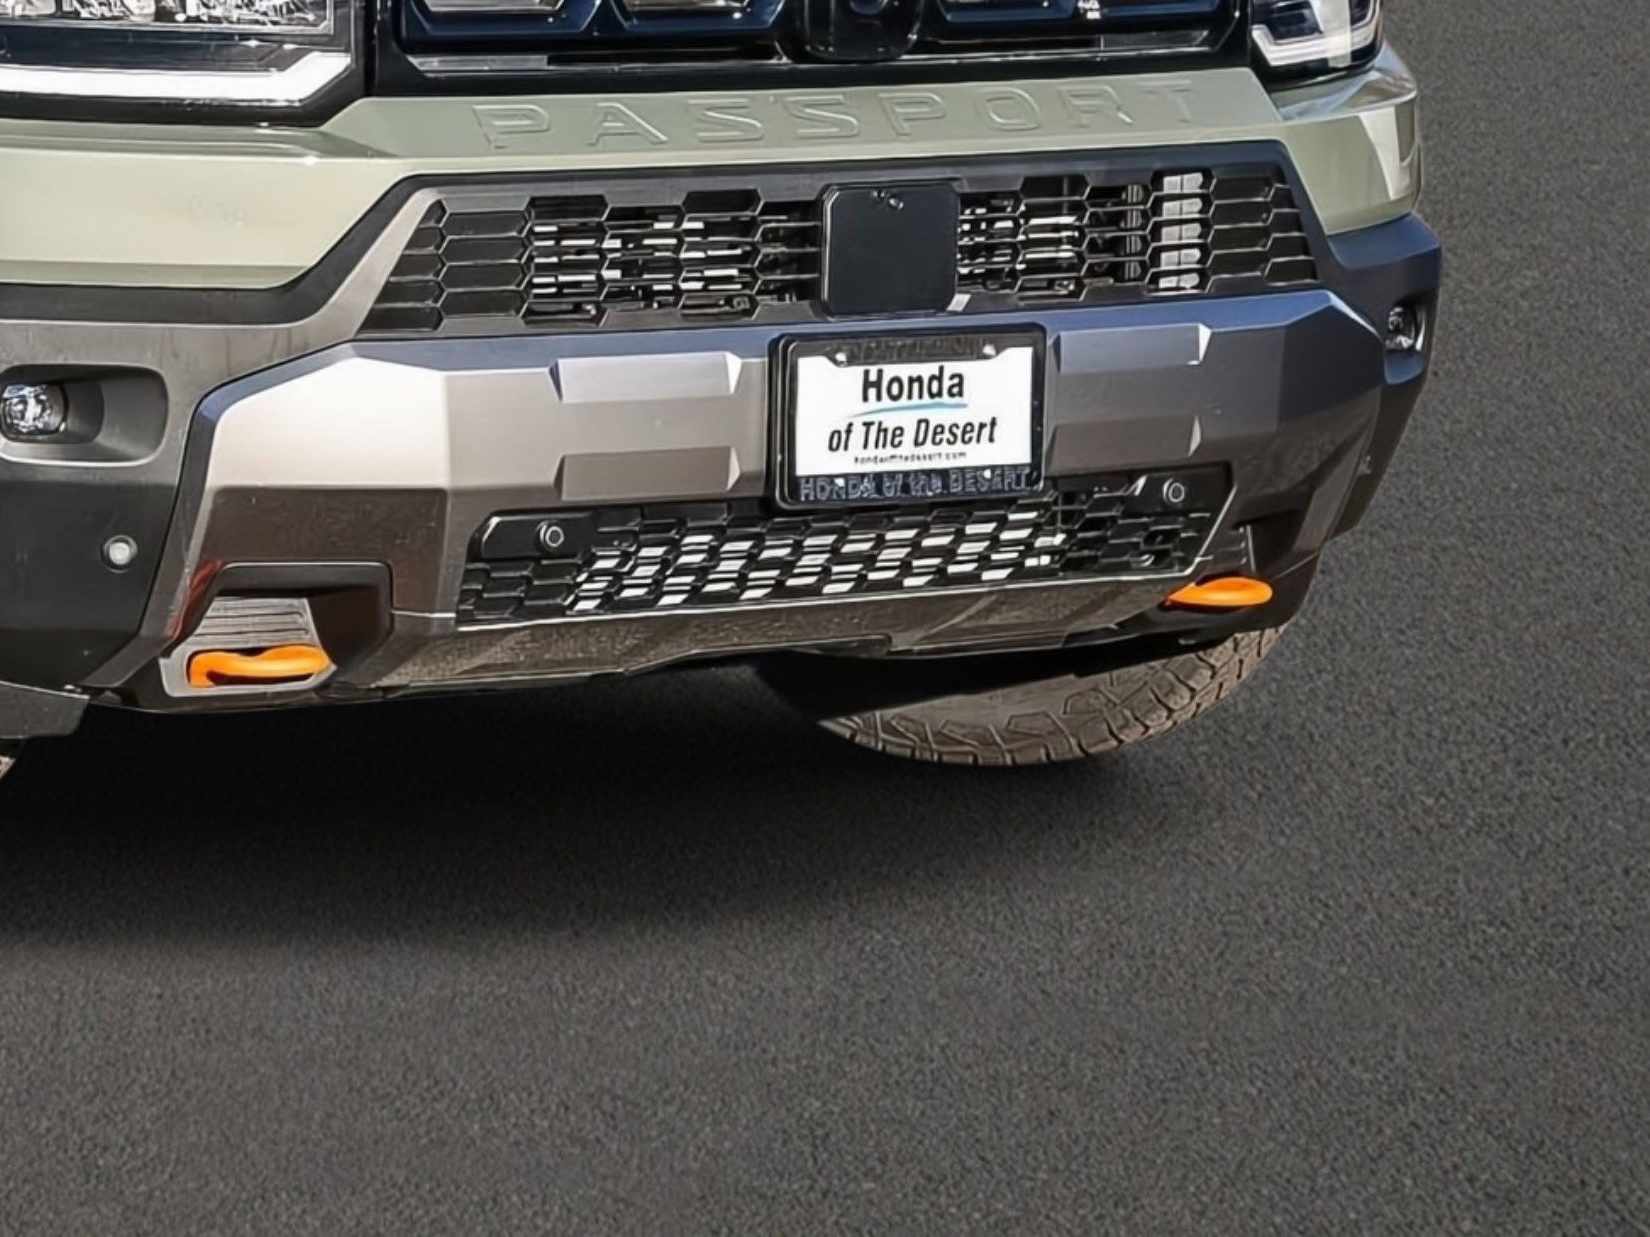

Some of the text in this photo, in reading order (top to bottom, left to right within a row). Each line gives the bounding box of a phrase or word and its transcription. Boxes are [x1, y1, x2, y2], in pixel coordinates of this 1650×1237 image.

[471, 78, 1193, 150] PASSPORT
[861, 365, 965, 403] Honda
[827, 416, 998, 452] of The Desert
